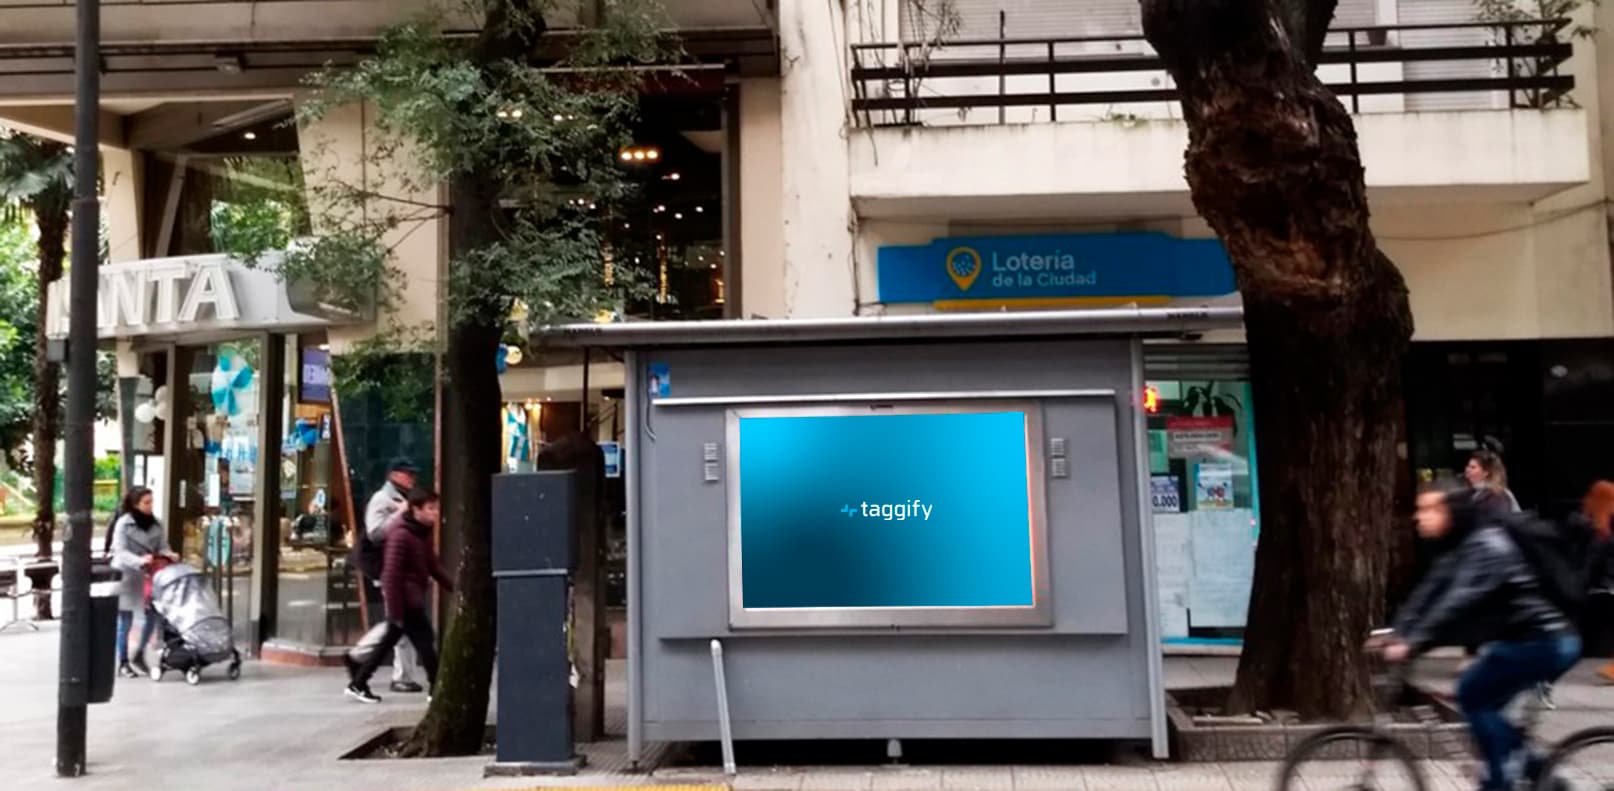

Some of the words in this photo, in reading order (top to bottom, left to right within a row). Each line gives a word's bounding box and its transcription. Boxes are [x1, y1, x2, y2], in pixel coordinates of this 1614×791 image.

[991, 249, 1075, 272] Lotería
[992, 273, 1014, 287] de
[1018, 272, 1033, 287] la
[1036, 270, 1097, 287] Ciudad
[860, 499, 933, 521] taggify
